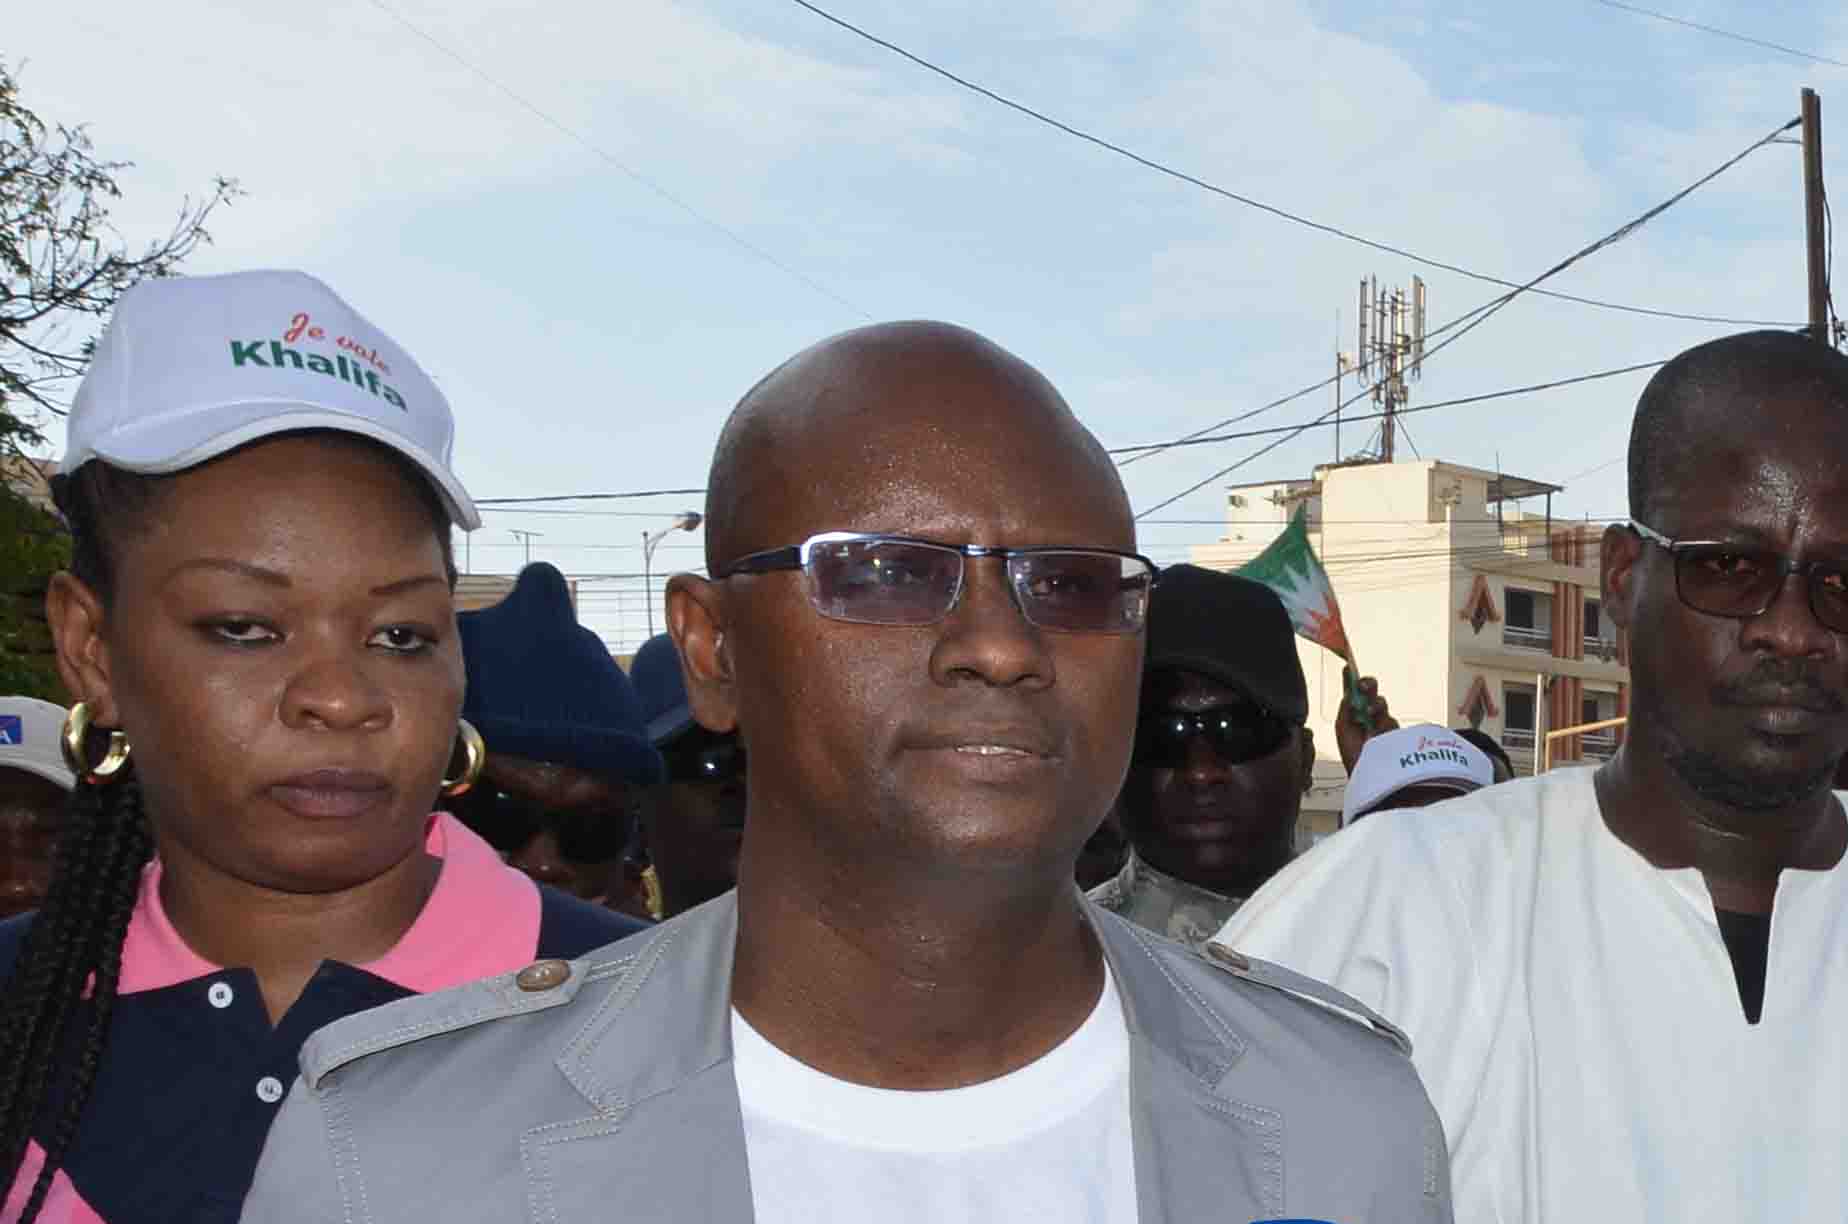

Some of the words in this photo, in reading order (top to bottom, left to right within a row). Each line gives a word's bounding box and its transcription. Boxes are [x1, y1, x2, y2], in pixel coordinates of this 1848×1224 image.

[283, 312, 324, 343] Je
[230, 338, 408, 413] Khalifa
[1399, 749, 1469, 769] Khalifa
